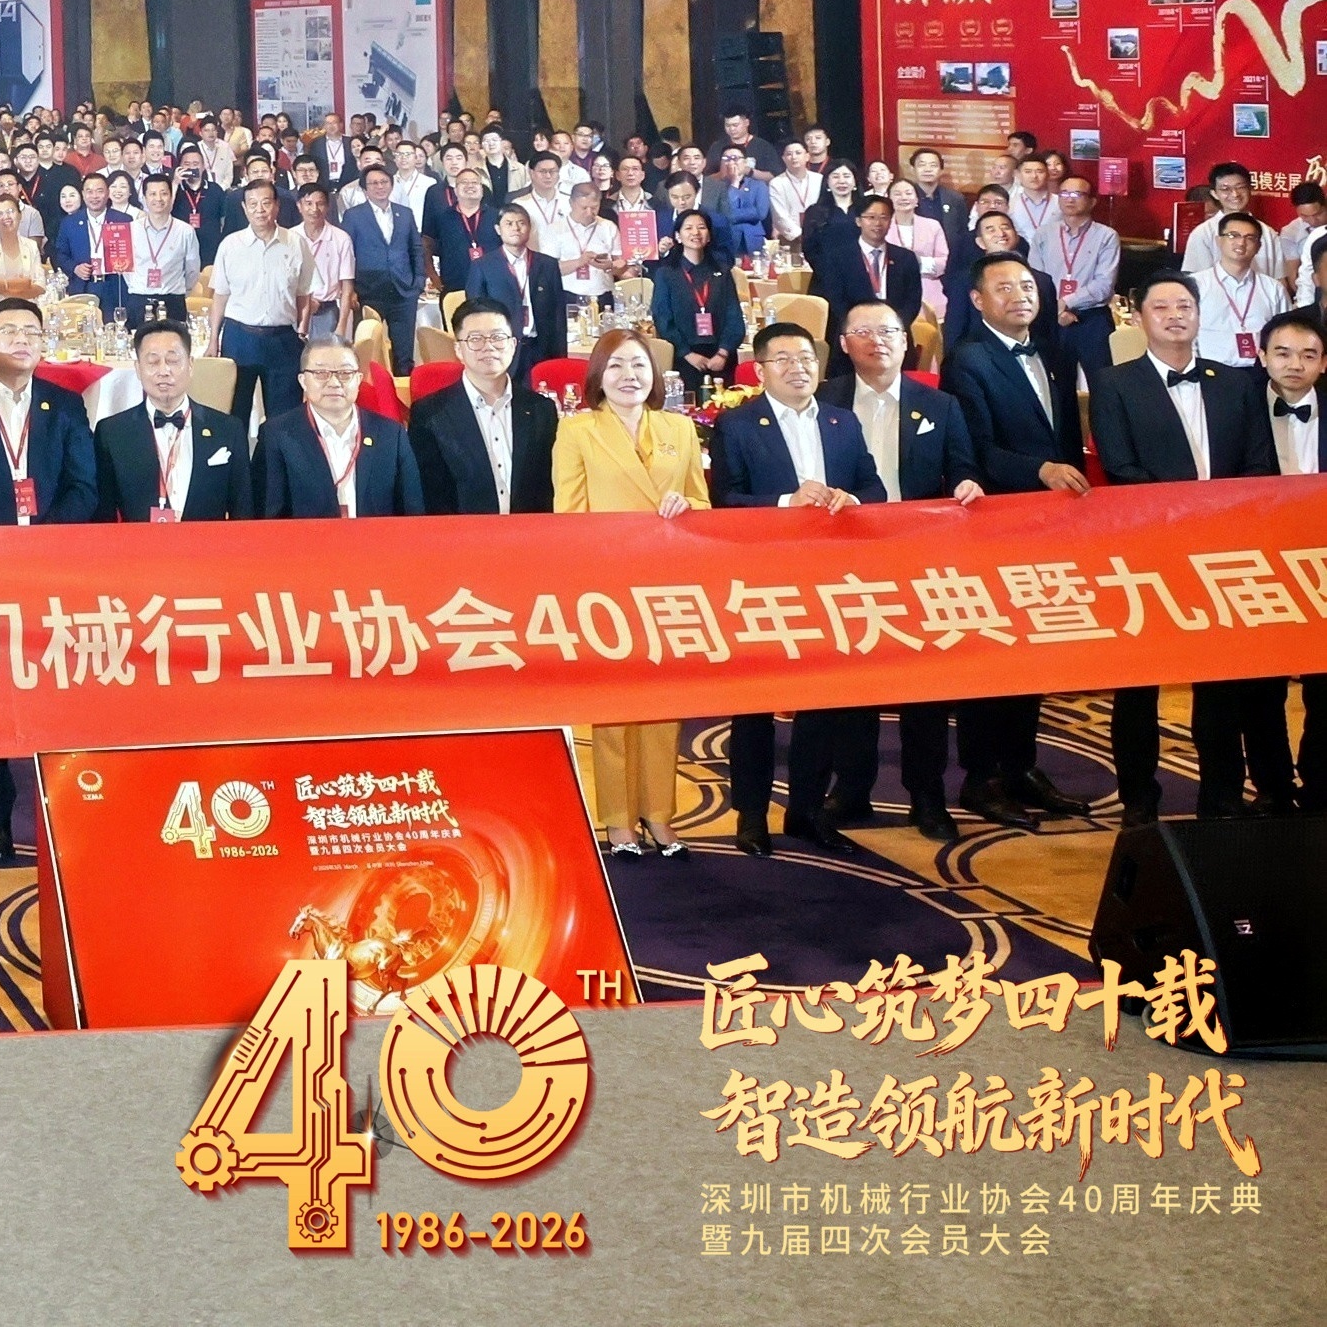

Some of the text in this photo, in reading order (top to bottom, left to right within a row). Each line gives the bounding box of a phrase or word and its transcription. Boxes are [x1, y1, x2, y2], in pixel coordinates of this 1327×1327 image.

[295, 769, 441, 803] 匠心筑梦四十载
[302, 798, 458, 831] 智造领航新时代
[307, 828, 462, 845] 深圳市机械行业协会40周年庆典
[219, 844, 279, 859] 1986-2026
[309, 842, 407, 856] 暨九届四次会员大会
